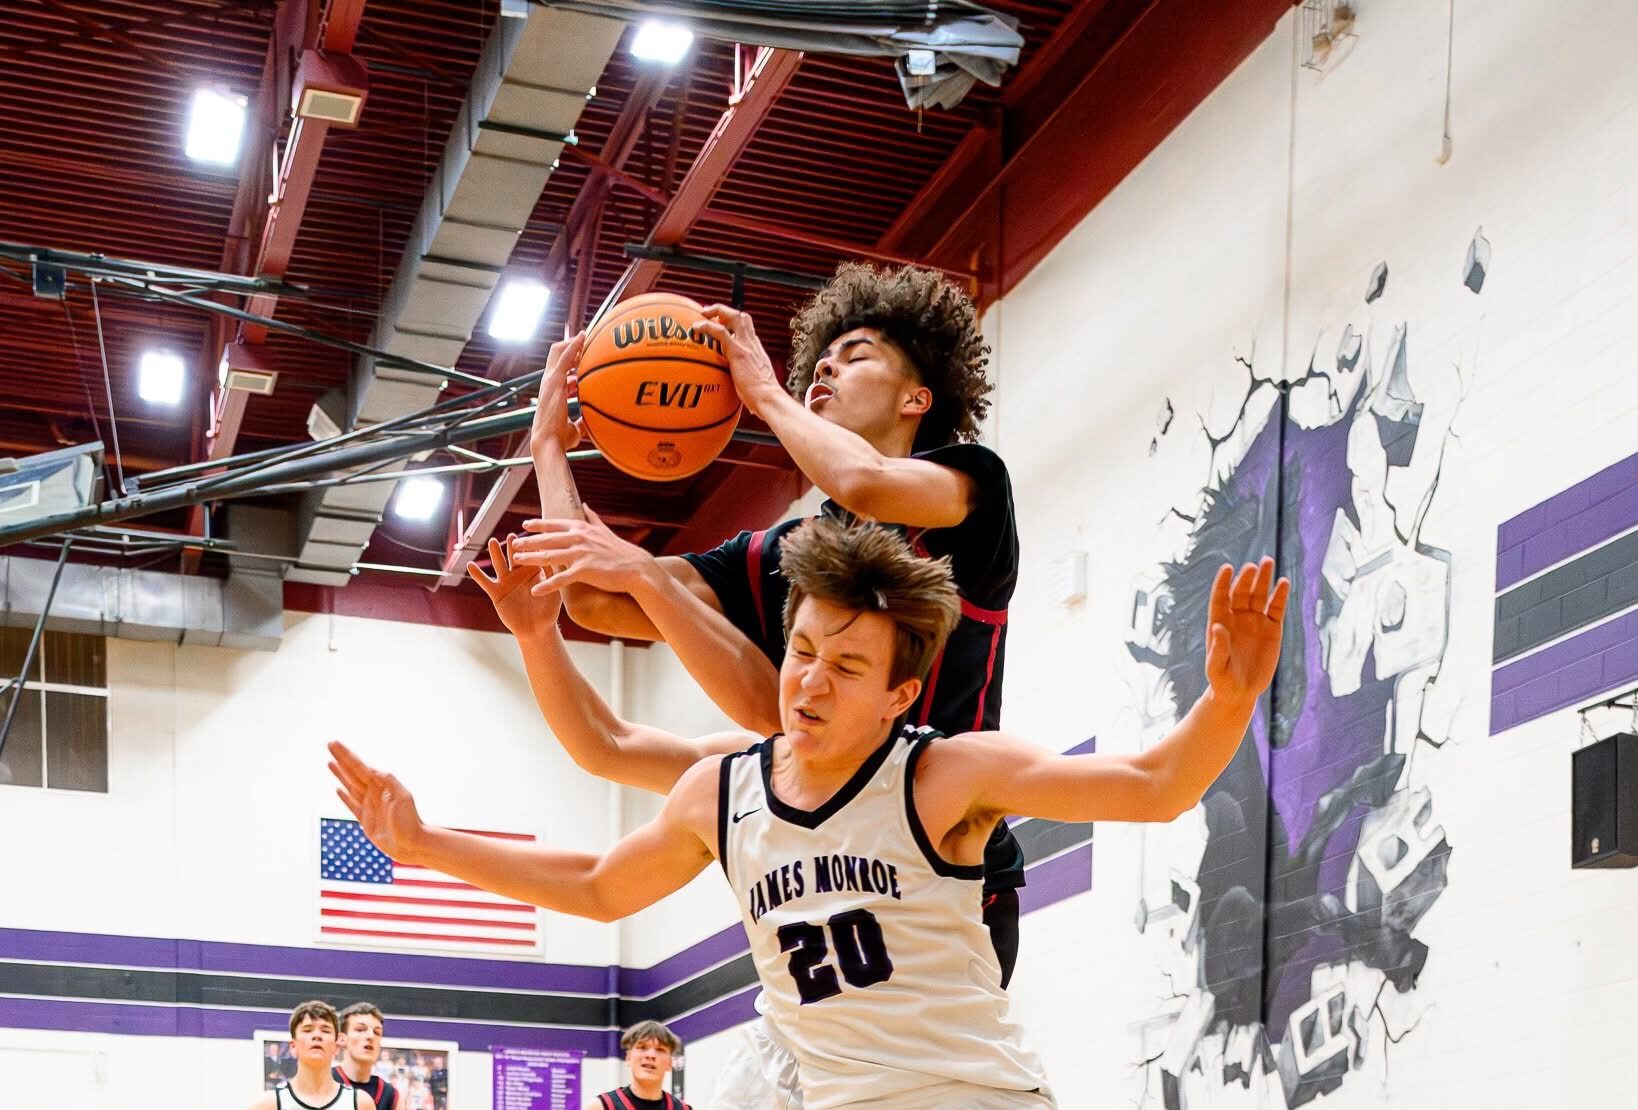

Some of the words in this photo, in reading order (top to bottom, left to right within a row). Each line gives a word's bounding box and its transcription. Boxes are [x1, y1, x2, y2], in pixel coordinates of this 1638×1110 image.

[636, 381, 703, 408] EVO
[750, 861, 804, 925] JAMES
[814, 854, 902, 900] MONROE
[777, 908, 894, 1005] 20
